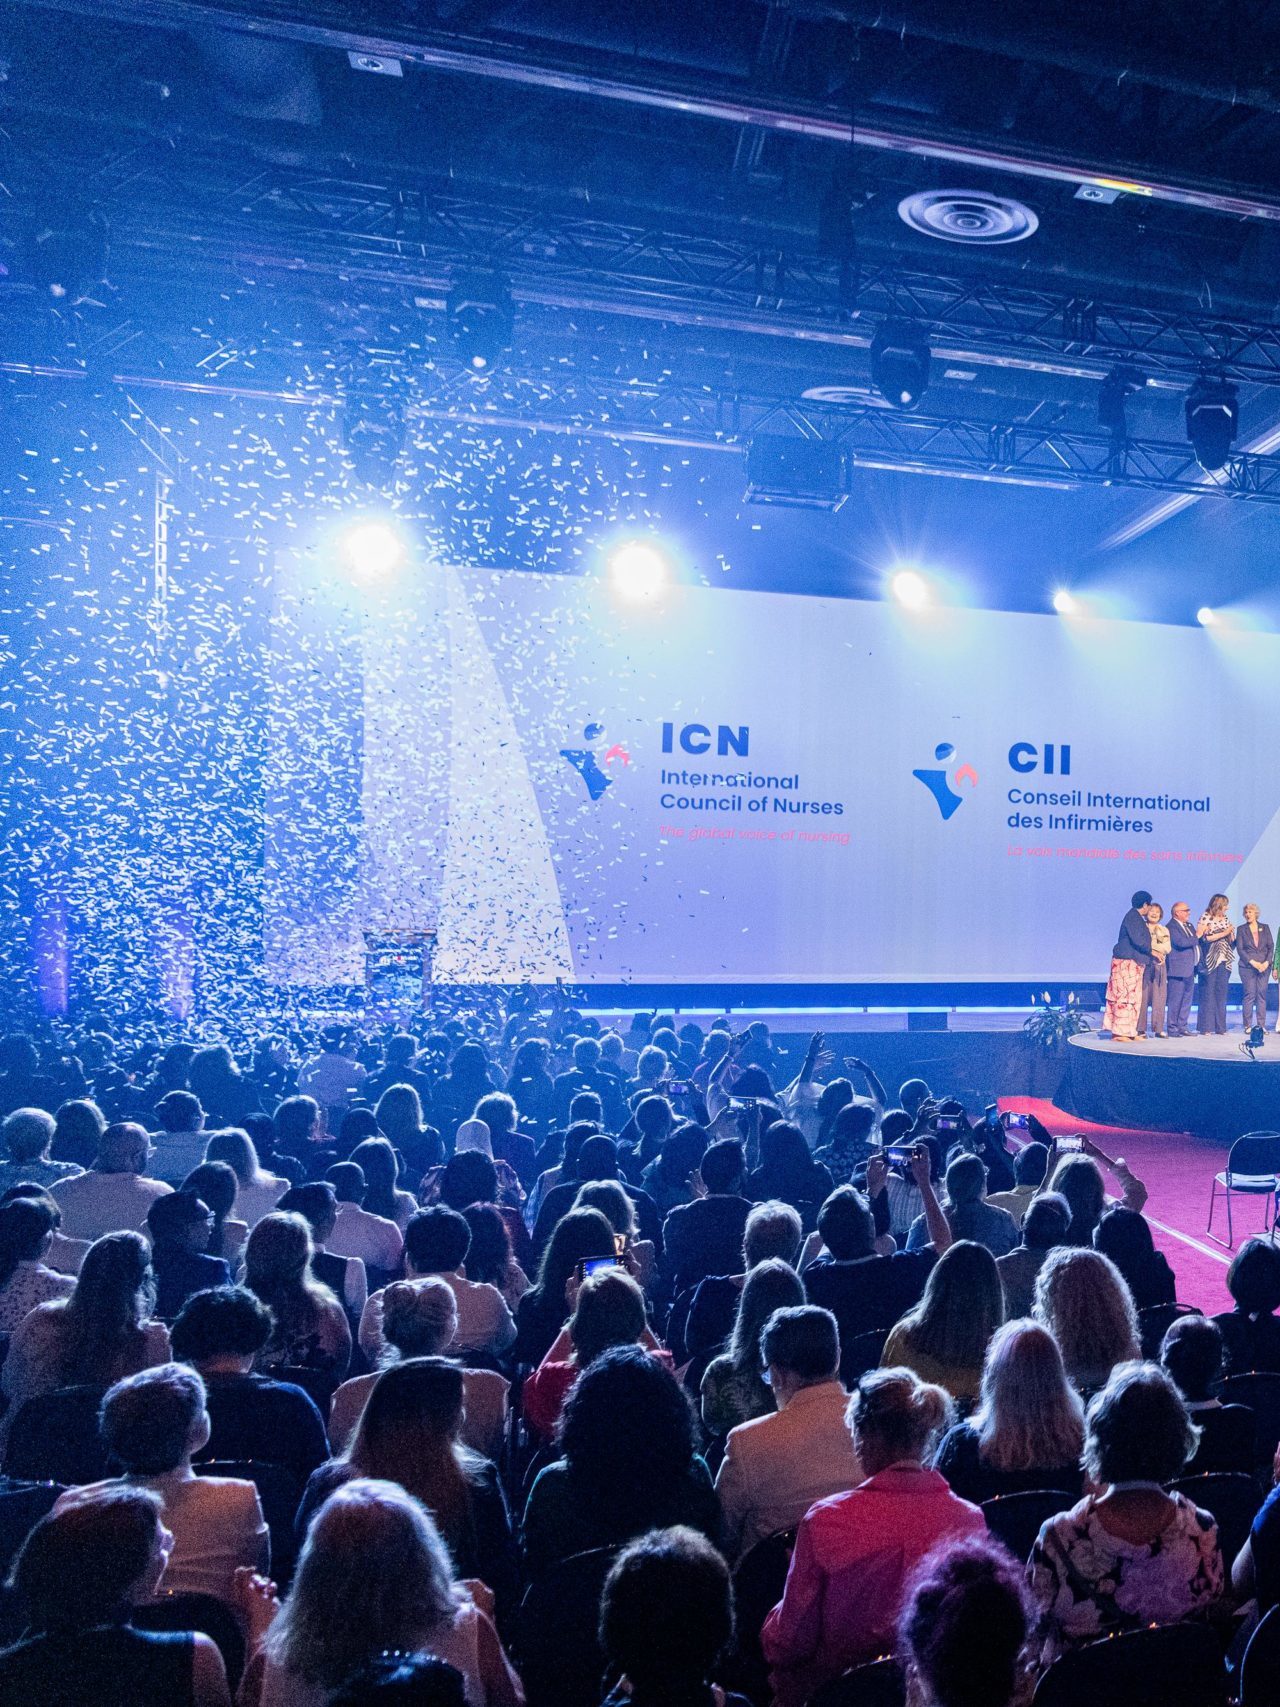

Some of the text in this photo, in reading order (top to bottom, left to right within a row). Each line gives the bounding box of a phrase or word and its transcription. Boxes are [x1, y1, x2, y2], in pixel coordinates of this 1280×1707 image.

[661, 722, 750, 757] ICN
[1008, 742, 1071, 775] CII
[661, 769, 799, 790] International
[660, 793, 844, 815] Council of Nurses
[1007, 788, 1210, 812] Conseil International
[1007, 812, 1153, 833] des Infirmières
[798, 830, 851, 846] nursing
